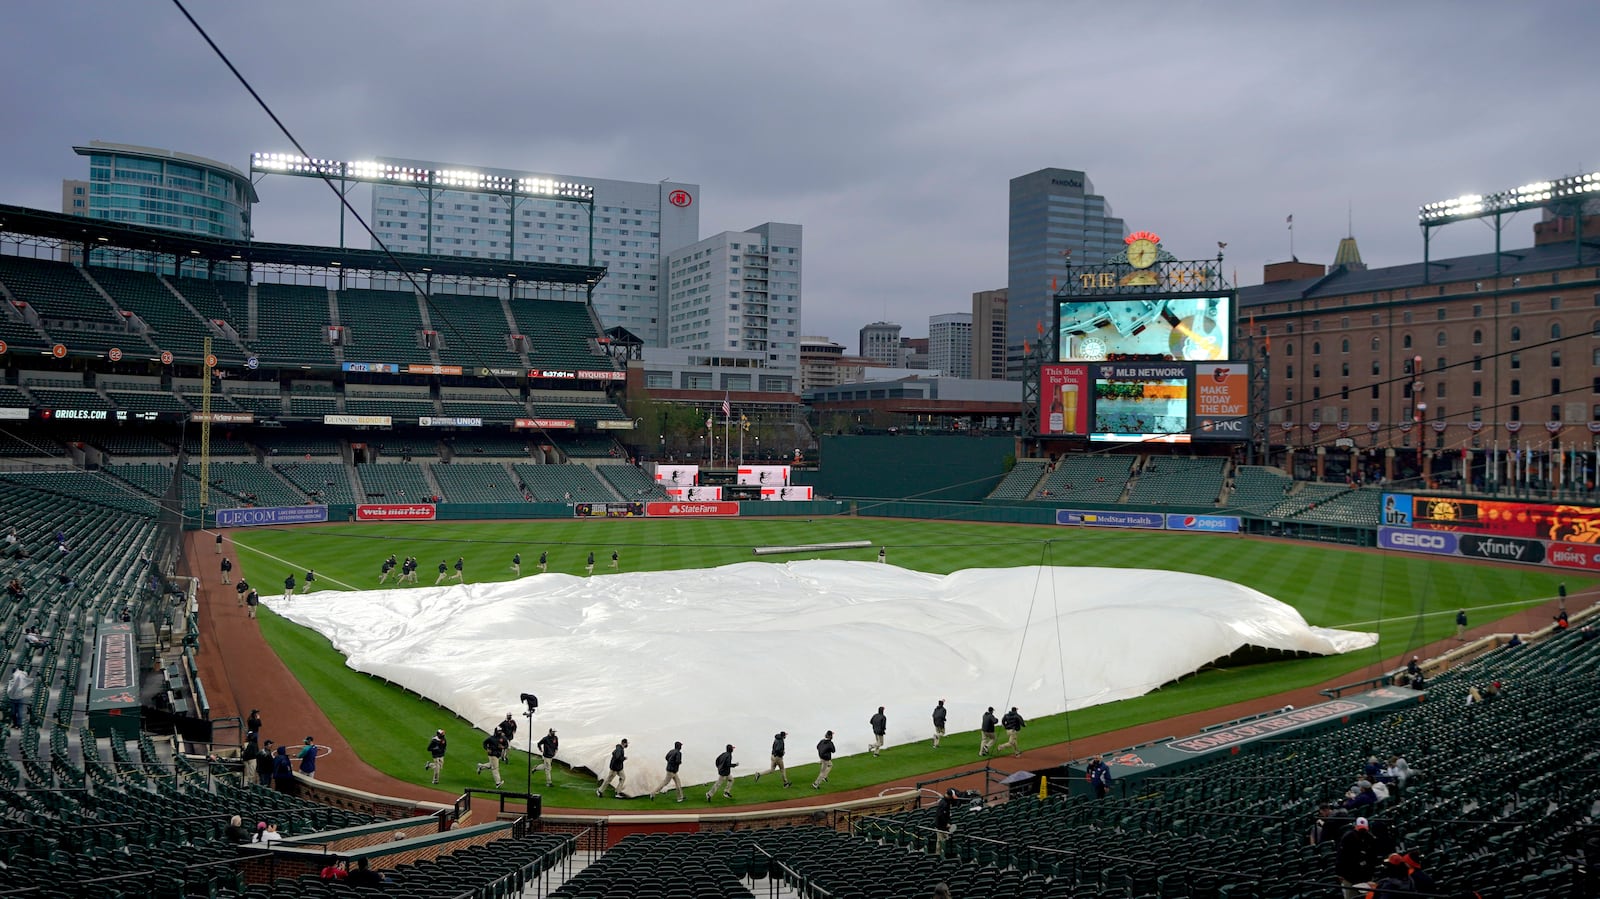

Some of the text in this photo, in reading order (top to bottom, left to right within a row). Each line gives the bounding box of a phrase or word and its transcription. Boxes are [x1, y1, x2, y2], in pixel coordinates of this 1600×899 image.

[1079, 272, 1116, 288] THE
[1045, 368, 1084, 376] This Bud's
[1116, 368, 1185, 377] MLB NETWORK
[1050, 376, 1079, 384] For You.
[1200, 386, 1229, 395] MAKE
[1200, 395, 1231, 404] TODAY
[55, 409, 107, 419] ORIOLES.COM
[1200, 405, 1220, 414] THE
[456, 417, 482, 425] UNION
[1215, 421, 1242, 431] PNC
[362, 506, 430, 516] weis markets
[223, 510, 276, 524] LECOM
[1097, 515, 1151, 525] MedStar Health
[1386, 510, 1409, 525] utz
[1198, 519, 1226, 528] pepsi
[1391, 532, 1445, 549] GEICO
[1477, 538, 1525, 559] xfinity
[1553, 551, 1587, 565] HIGH'S
